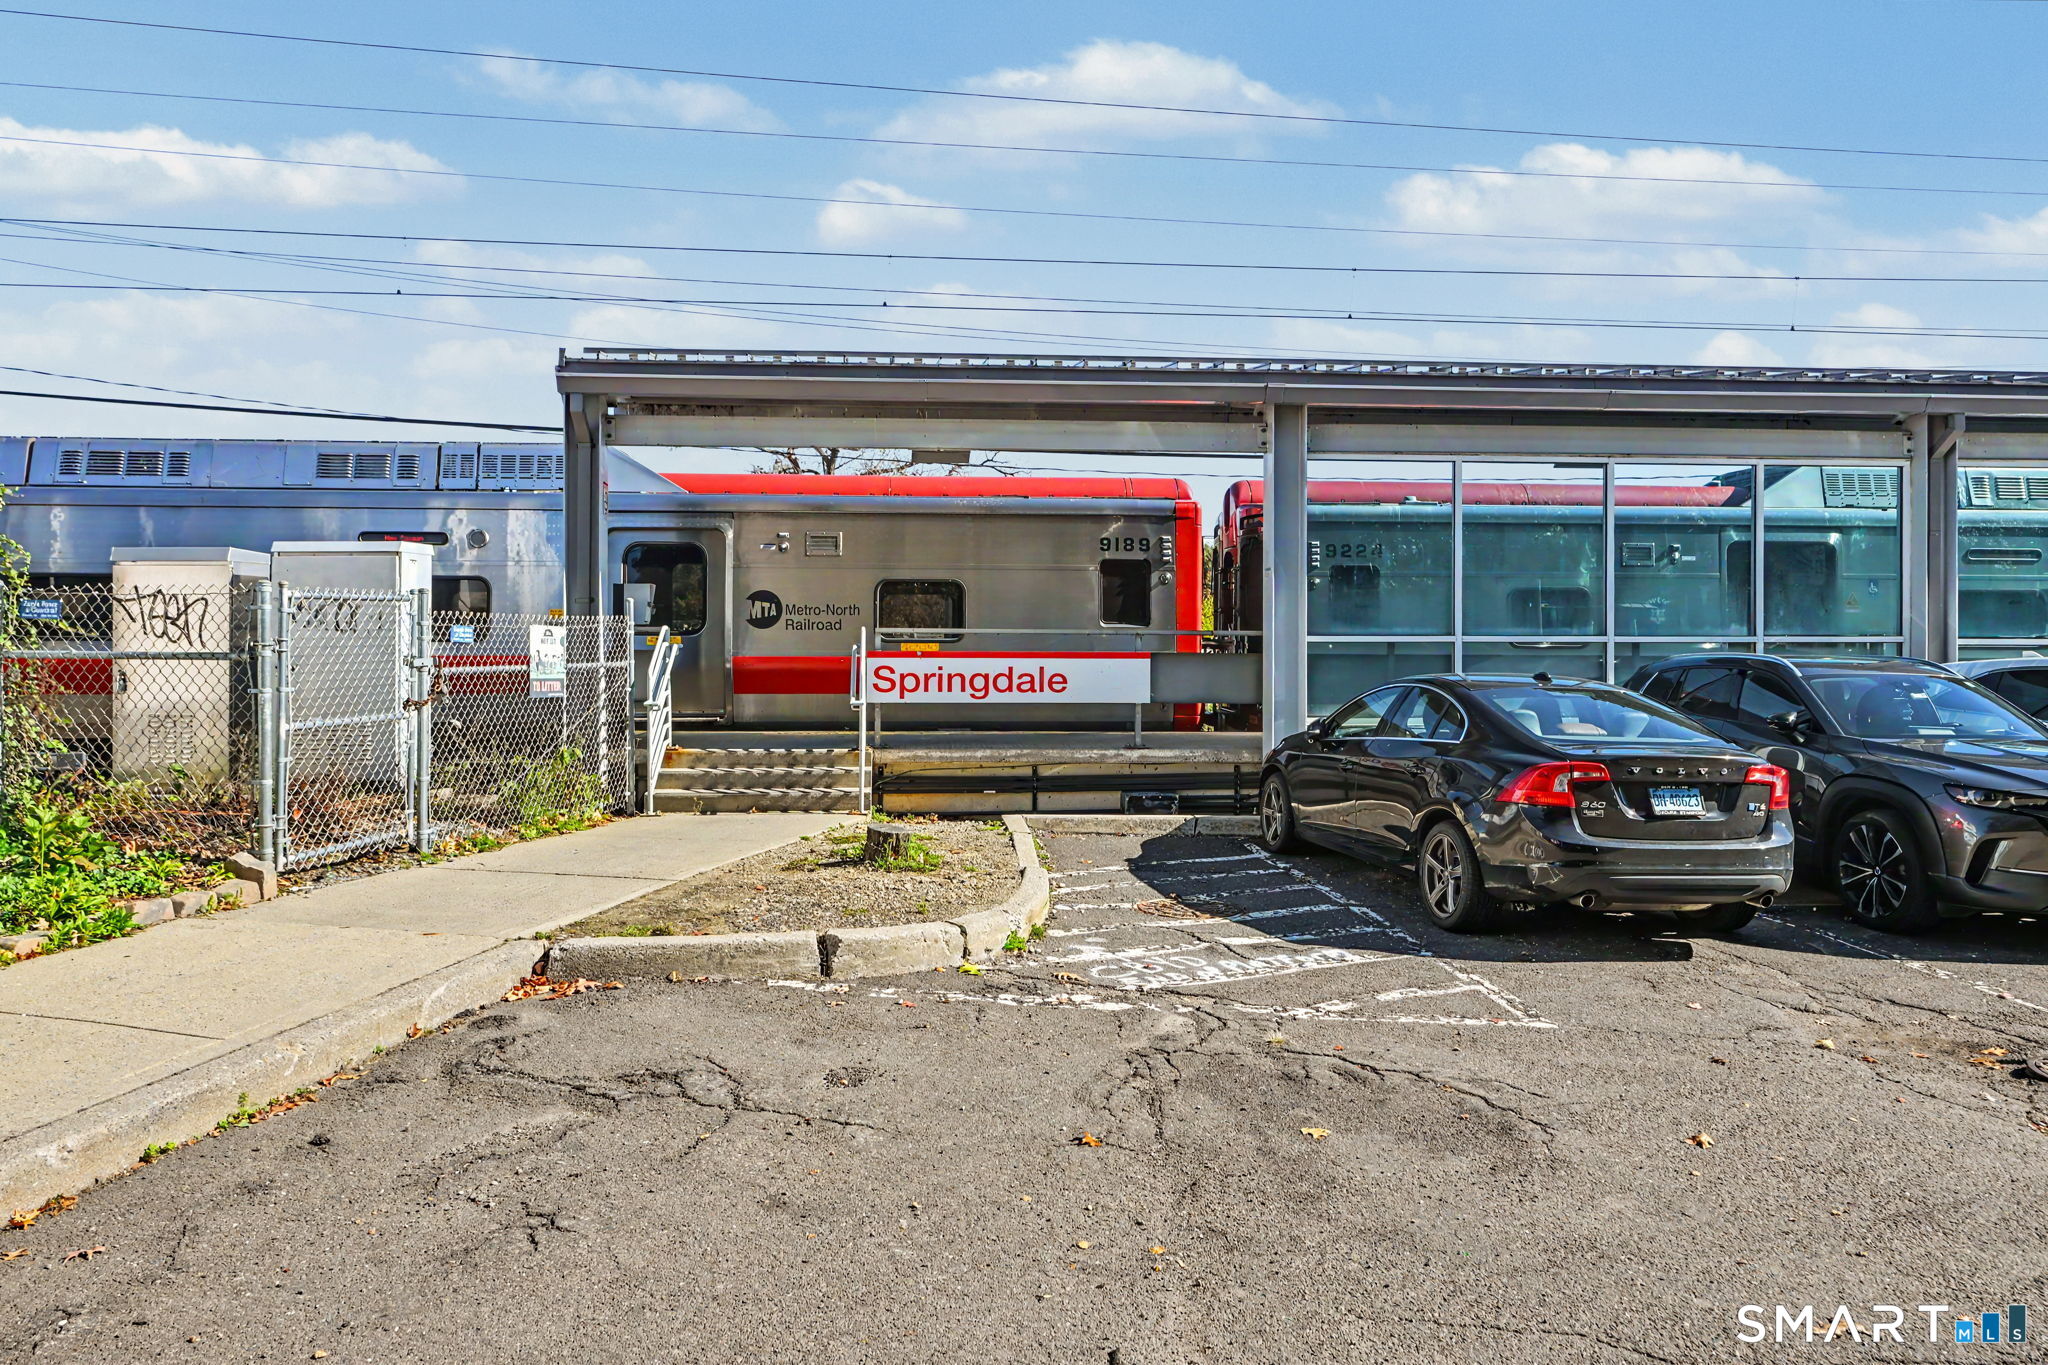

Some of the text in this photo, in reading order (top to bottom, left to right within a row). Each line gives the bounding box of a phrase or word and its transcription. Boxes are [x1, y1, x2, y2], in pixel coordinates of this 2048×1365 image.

[1100, 537, 1151, 552] 9189
[746, 599, 777, 619] MTA
[785, 603, 860, 616] Metro-North
[785, 618, 842, 631] Railroad
[541, 681, 562, 692] LITTER
[872, 665, 1068, 700] Springdale
